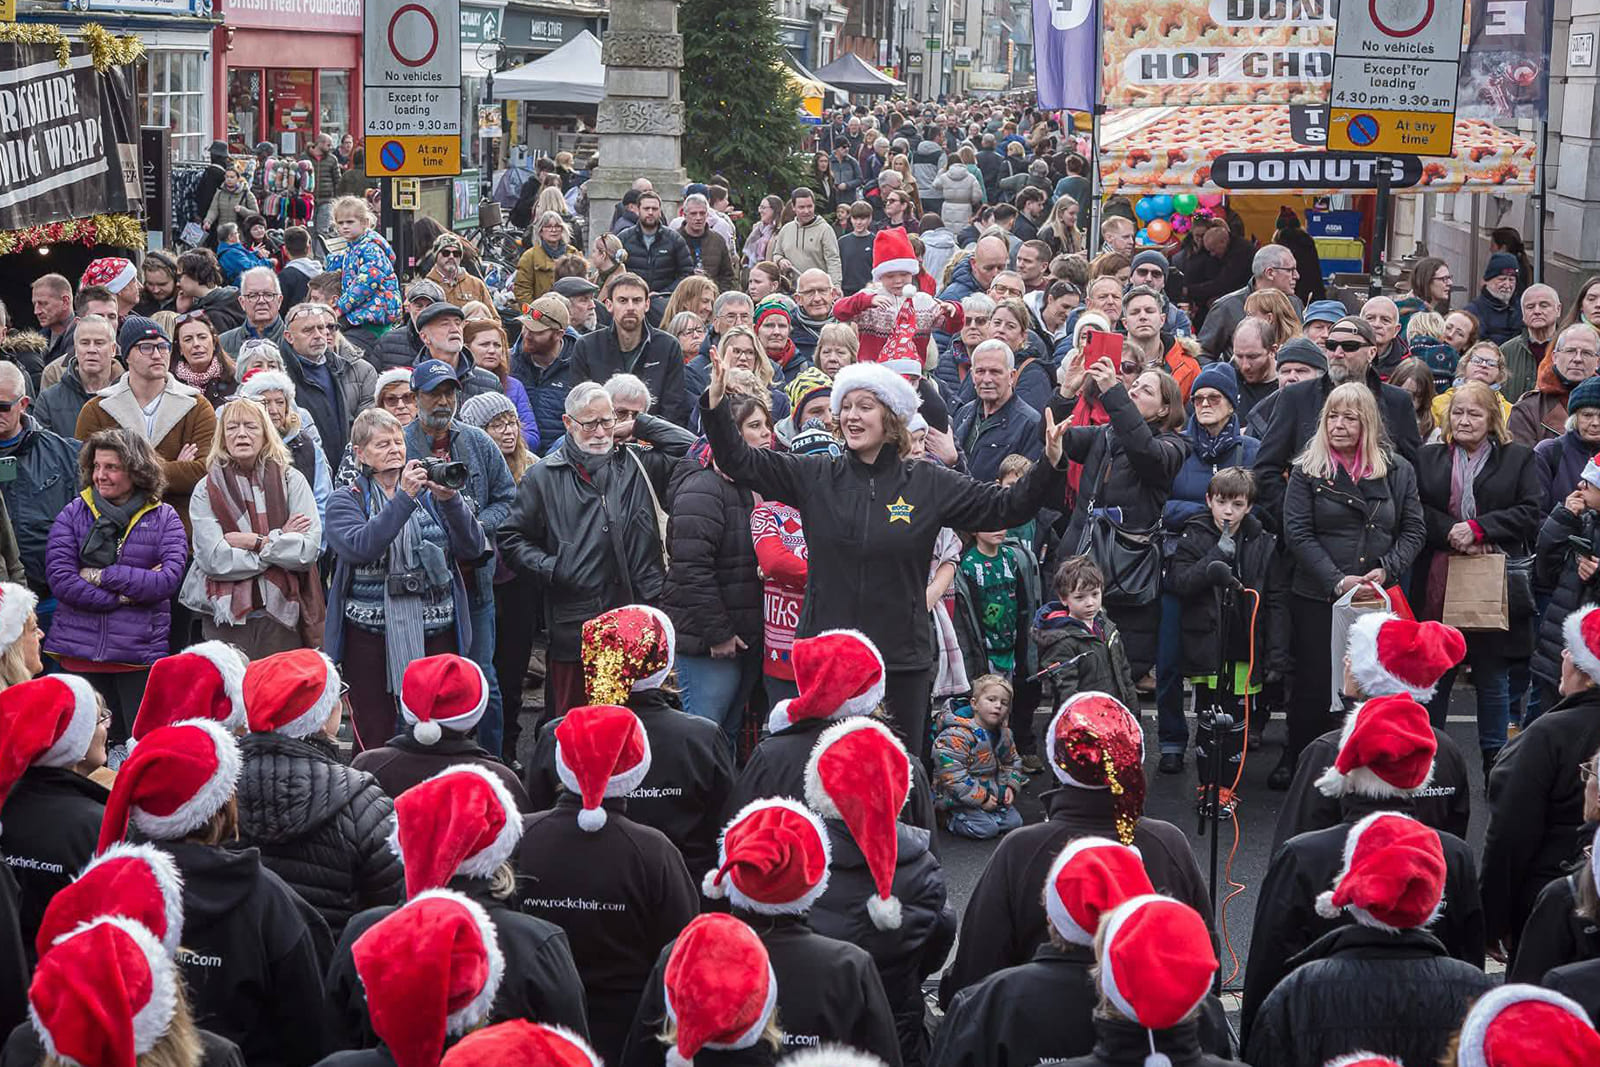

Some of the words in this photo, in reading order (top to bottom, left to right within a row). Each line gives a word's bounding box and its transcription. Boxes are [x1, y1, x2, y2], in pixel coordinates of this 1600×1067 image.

[1227, 0, 1337, 21] DON
[1362, 40, 1380, 52] No
[1384, 41, 1435, 54] vehicles
[1141, 52, 1226, 80] HOT
[1363, 62, 1407, 77] Except
[1410, 63, 1430, 76] for
[385, 71, 400, 81] No
[403, 70, 442, 81] vehicles
[1370, 77, 1417, 91] loading
[0, 73, 79, 133] RKSHIRE
[388, 92, 422, 103] Except
[425, 92, 440, 102] for
[1336, 91, 1368, 103] 4.30
[1370, 94, 1389, 106] pm
[1399, 94, 1430, 106] 9.30
[1432, 97, 1451, 107] am
[394, 105, 431, 116] loading
[368, 120, 394, 131] 4.30
[395, 122, 411, 132] pm
[418, 120, 442, 131] 9.30
[443, 122, 457, 130] am
[1395, 120, 1410, 131] At
[1414, 122, 1437, 134] any
[1401, 134, 1430, 145] time
[417, 144, 428, 154] At
[432, 146, 449, 155] any
[423, 157, 444, 166] time
[624, 786, 682, 798] kchoir.com
[523, 897, 626, 912] www.rockchoir.com
